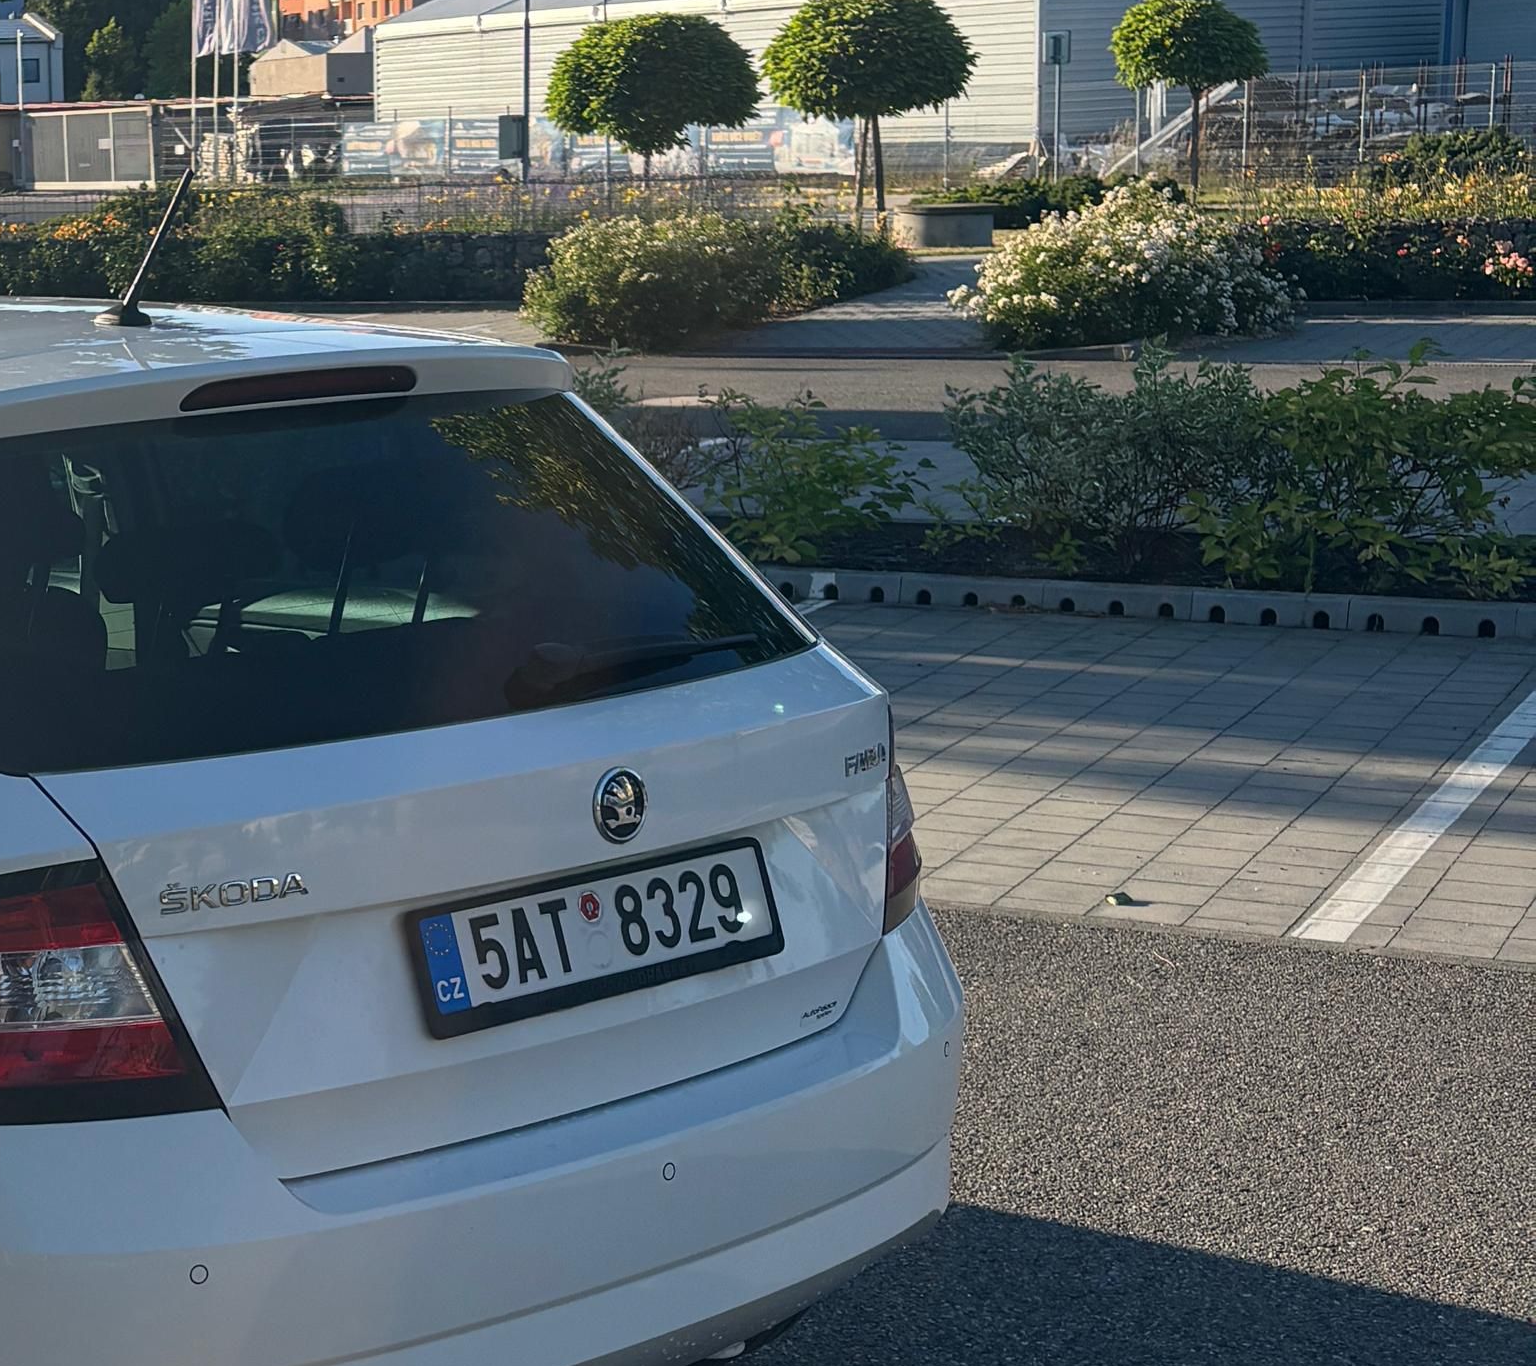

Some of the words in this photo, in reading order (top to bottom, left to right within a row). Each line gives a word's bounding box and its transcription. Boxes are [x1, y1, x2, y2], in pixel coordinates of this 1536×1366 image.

[159, 872, 309, 916] ŠKODA
[468, 897, 573, 989] 5AT
[614, 863, 746, 956] 8329
[435, 976, 465, 1004] CZ
